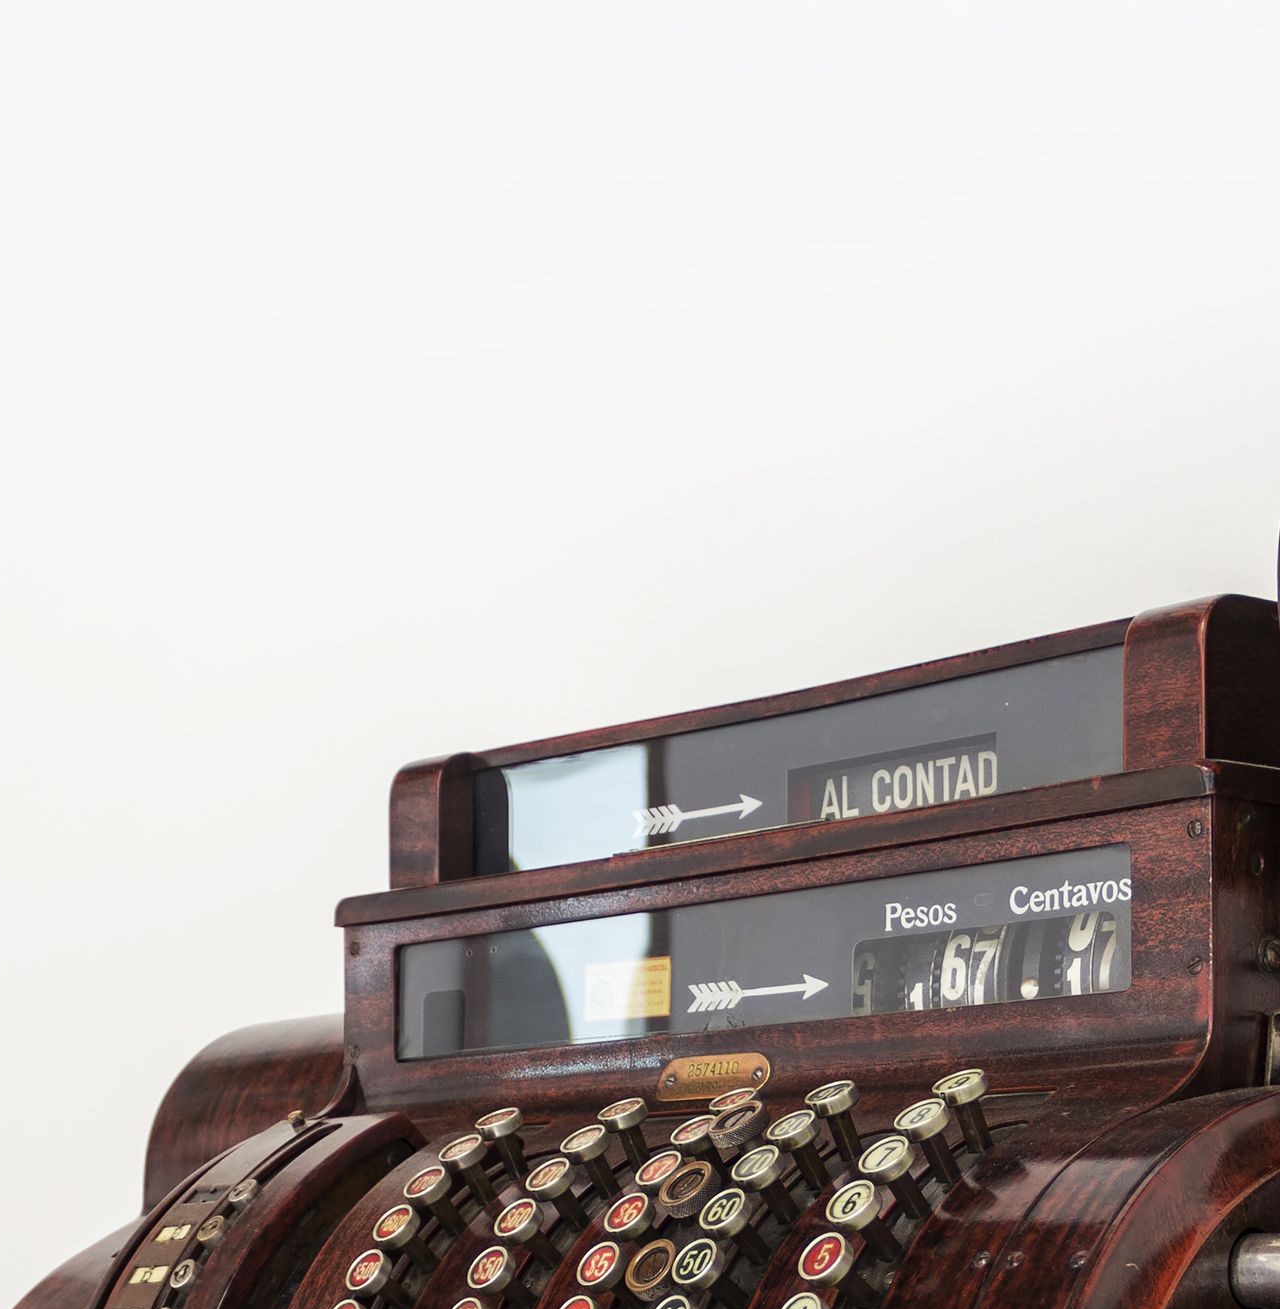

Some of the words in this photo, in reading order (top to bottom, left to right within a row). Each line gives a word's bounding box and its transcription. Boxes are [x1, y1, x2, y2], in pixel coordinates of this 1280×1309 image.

[820, 775, 859, 820] AL
[872, 751, 997, 812] CONTAD
[885, 901, 957, 931] Pesos
[1009, 877, 1131, 914] Centavos
[687, 1061, 739, 1077] 2574110
[909, 1107, 932, 1124] 8
[740, 1153, 773, 1175] 70
[878, 1147, 899, 1166] 7
[614, 1201, 641, 1224] $6
[708, 1198, 739, 1222] 60
[842, 1192, 861, 1215] 6
[499, 1208, 532, 1227] $60
[474, 1256, 504, 1280] $50
[585, 1251, 612, 1277] $5
[680, 1249, 711, 1275] 50
[814, 1244, 834, 1269] 5
